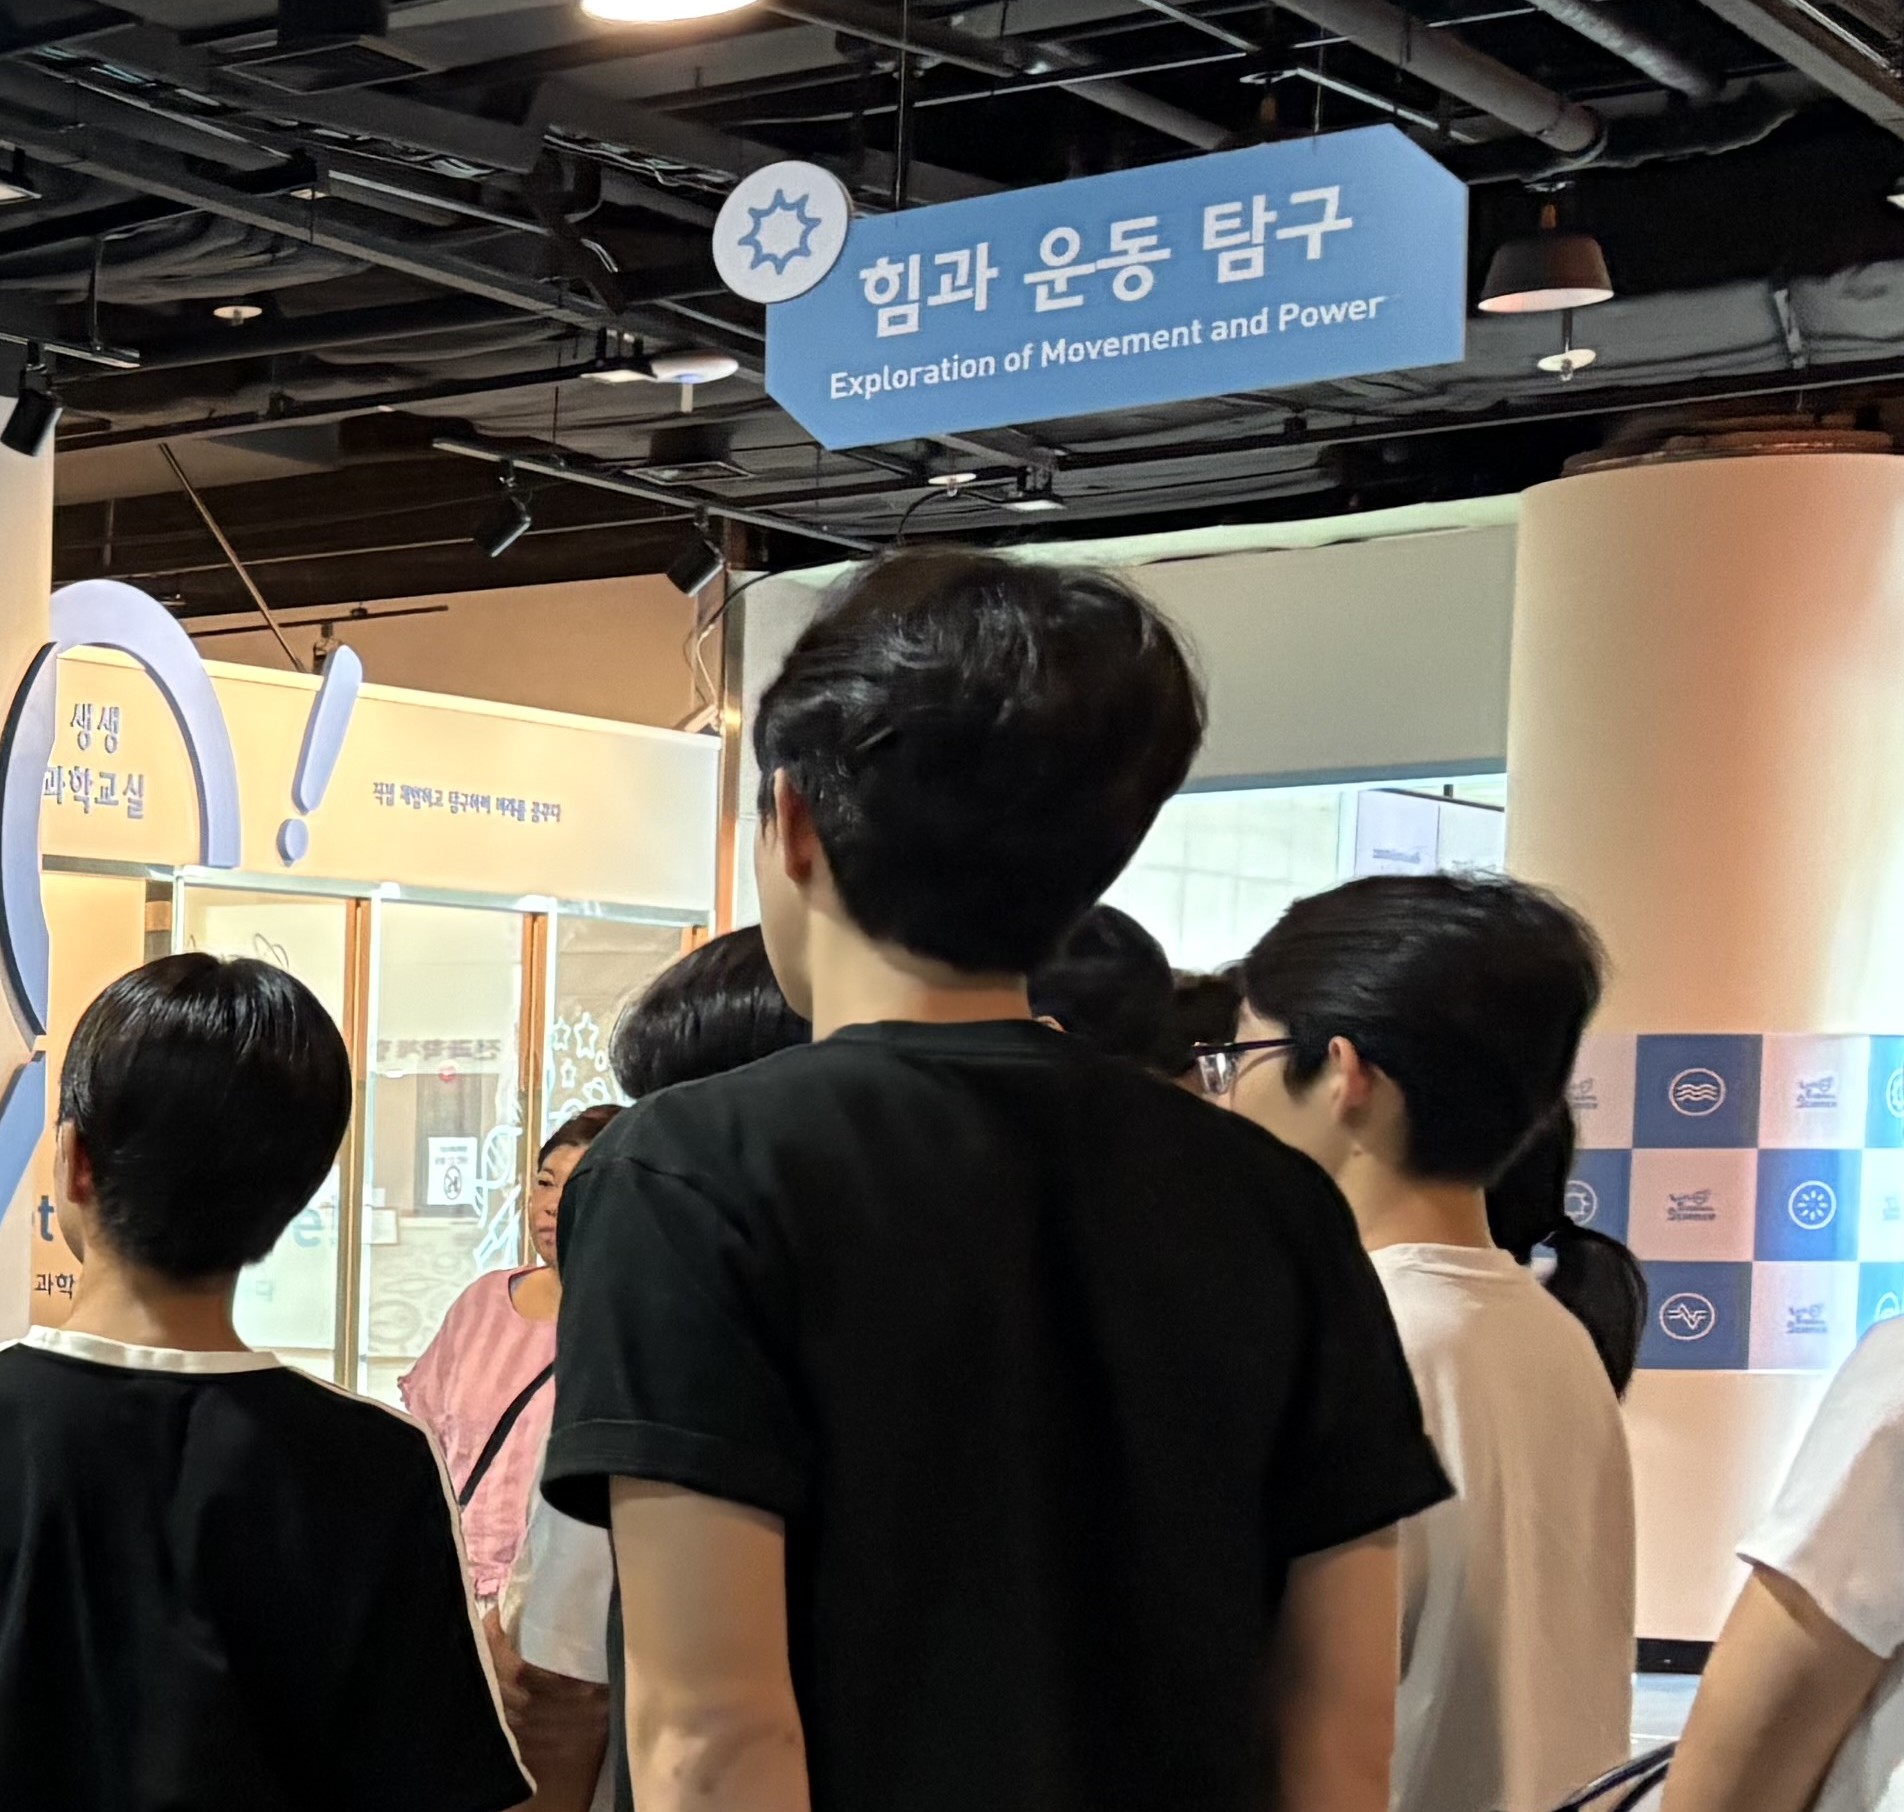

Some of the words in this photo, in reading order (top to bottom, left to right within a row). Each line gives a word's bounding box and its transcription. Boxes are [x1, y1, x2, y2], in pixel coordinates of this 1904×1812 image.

[859, 242, 999, 338] 힘과
[1024, 215, 1171, 313] 운동
[1202, 185, 1353, 284] 탐구
[830, 353, 994, 400] Exploration
[1004, 341, 1033, 372] of
[1040, 317, 1204, 368] Movement
[1210, 307, 1268, 342] and
[1277, 294, 1384, 331] Power
[70, 703, 120, 754] 생생
[43, 765, 144, 820] 과학교실
